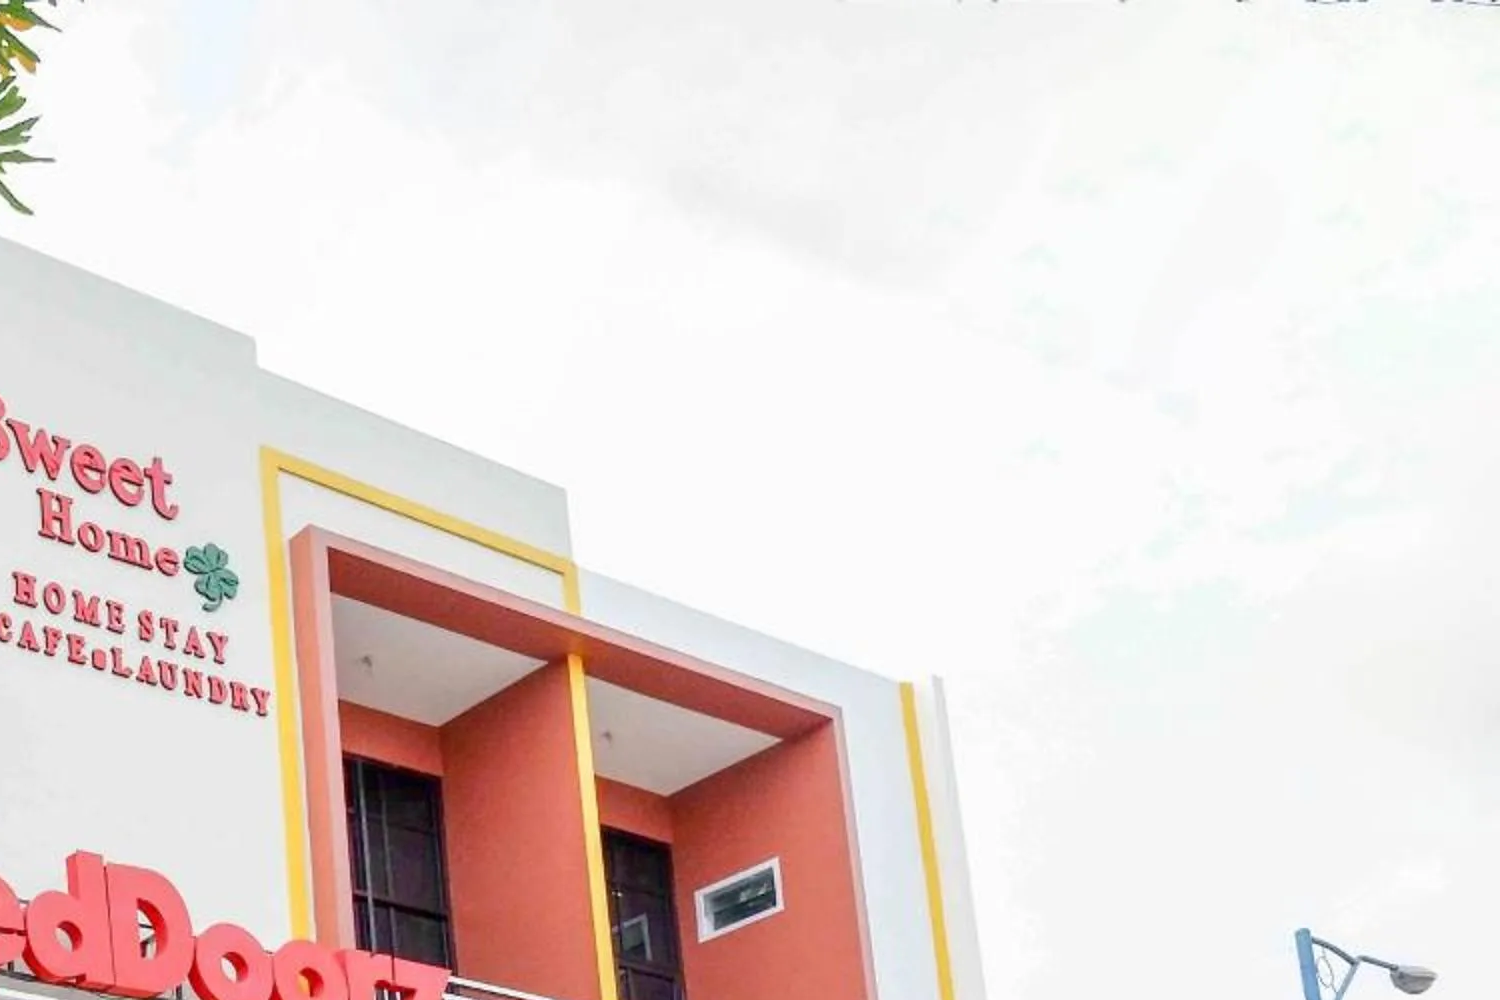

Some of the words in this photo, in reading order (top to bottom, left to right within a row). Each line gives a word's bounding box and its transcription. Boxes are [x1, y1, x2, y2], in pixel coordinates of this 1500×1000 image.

[36, 487, 181, 577] Home
[11, 571, 126, 634] HOME
[137, 608, 230, 664] STAY
[110, 645, 271, 717] LAUNDRY
